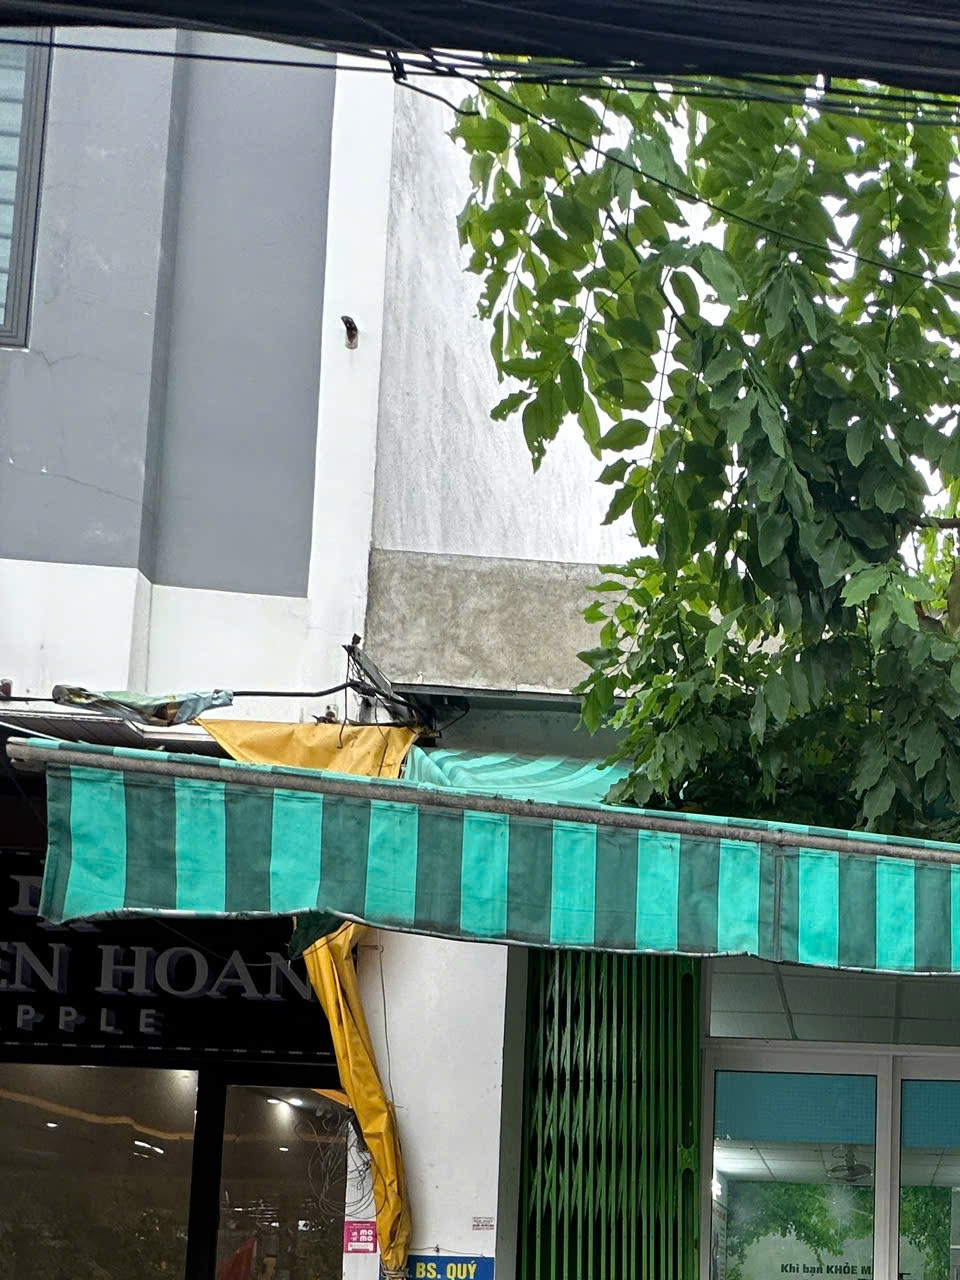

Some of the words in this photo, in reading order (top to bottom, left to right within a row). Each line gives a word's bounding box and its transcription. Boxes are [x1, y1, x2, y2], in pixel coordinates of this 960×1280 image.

[0, 1003, 161, 1036] PPLE
[415, 1262, 442, 1279] BS.
[446, 1260, 478, 1280] QUÝ
[781, 1263, 799, 1274] Khi
[803, 1263, 823, 1277] bạn
[826, 1262, 858, 1275] KHỎE
